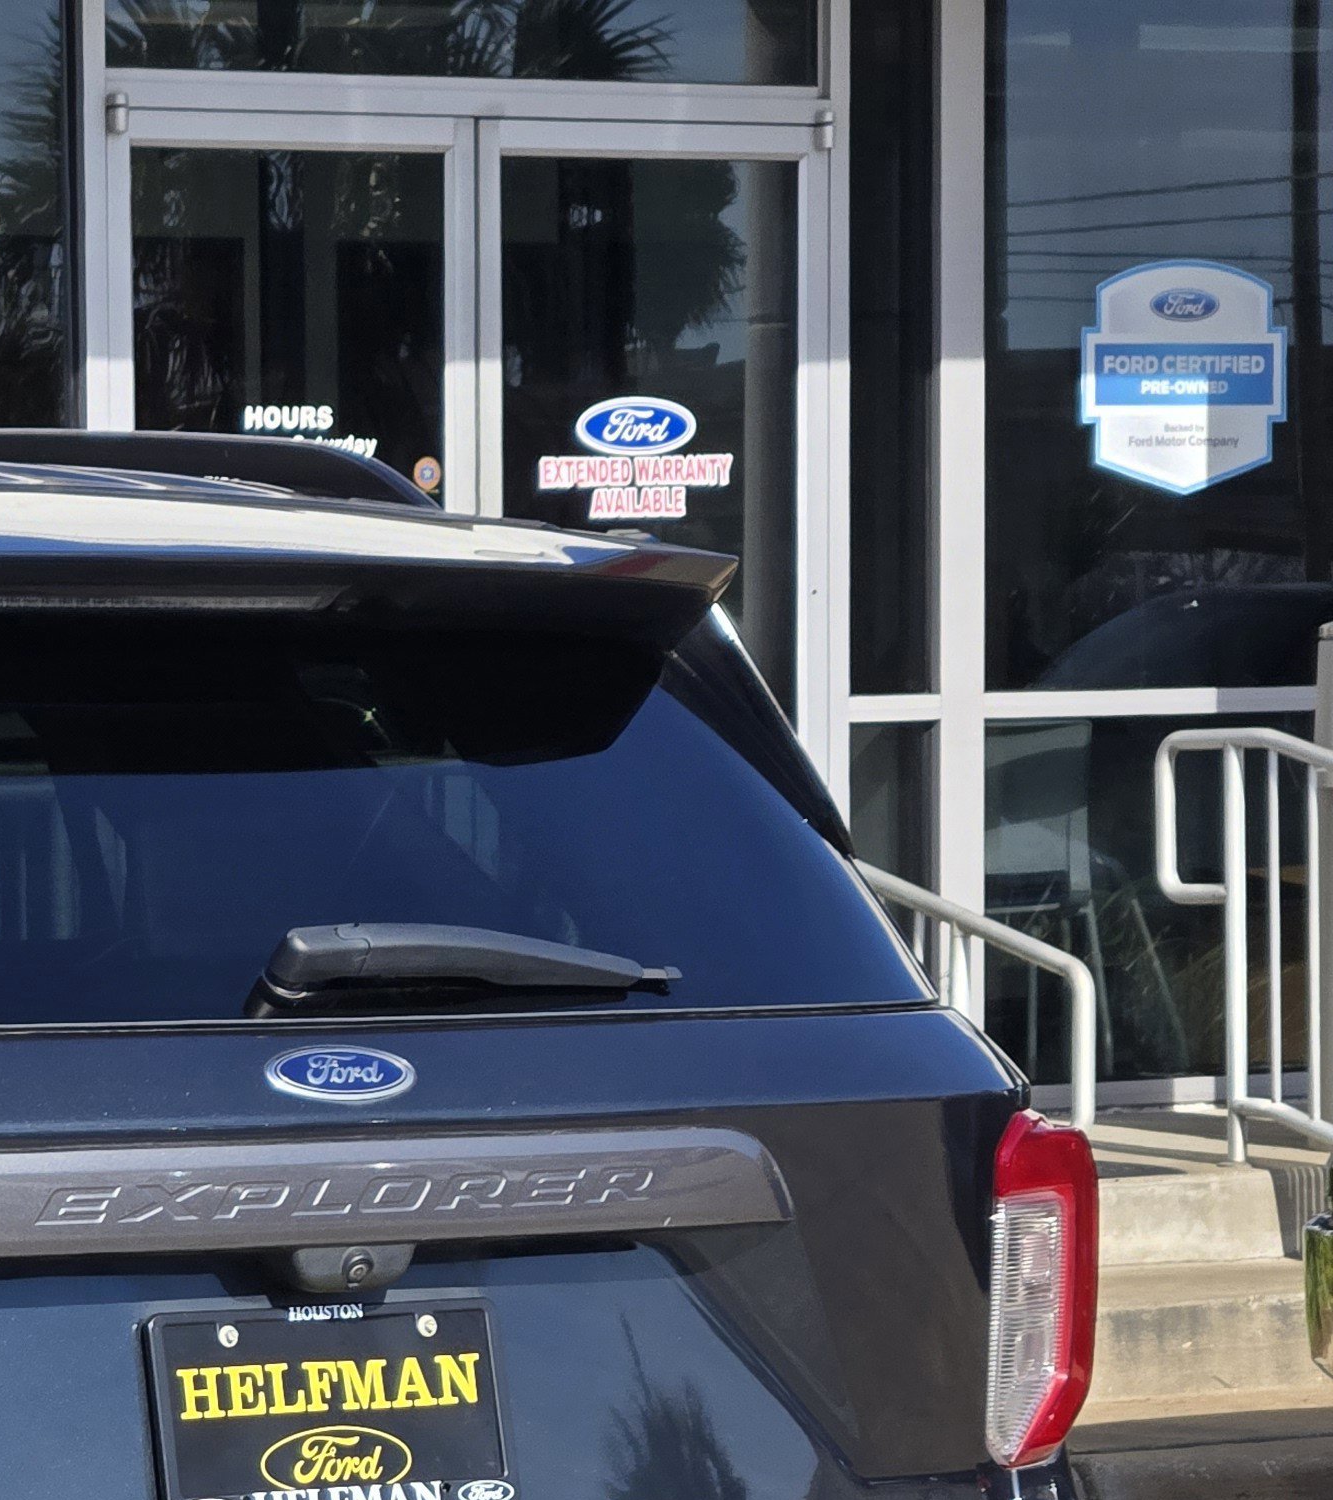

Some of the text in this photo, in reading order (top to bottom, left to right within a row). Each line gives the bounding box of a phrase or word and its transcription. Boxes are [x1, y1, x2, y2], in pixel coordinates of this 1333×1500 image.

[1163, 294, 1205, 316] Ford
[1102, 355, 1266, 375] FORD CERTIFIED
[1140, 380, 1229, 395] PRE-OWNED
[243, 405, 334, 431] HOURS
[601, 408, 669, 443] Ford
[1164, 424, 1193, 433] Backed
[1128, 436, 1240, 449] Ford Motor Company
[540, 454, 732, 488] EXTENDED WARRANTY
[589, 486, 686, 517] AVAILABLE
[306, 1054, 384, 1086] Ford
[33, 1166, 656, 1227] EXPLORER
[288, 1303, 364, 1323] HOUSTON
[176, 1352, 480, 1421] HELFMAN
[293, 1436, 384, 1484] Ford
